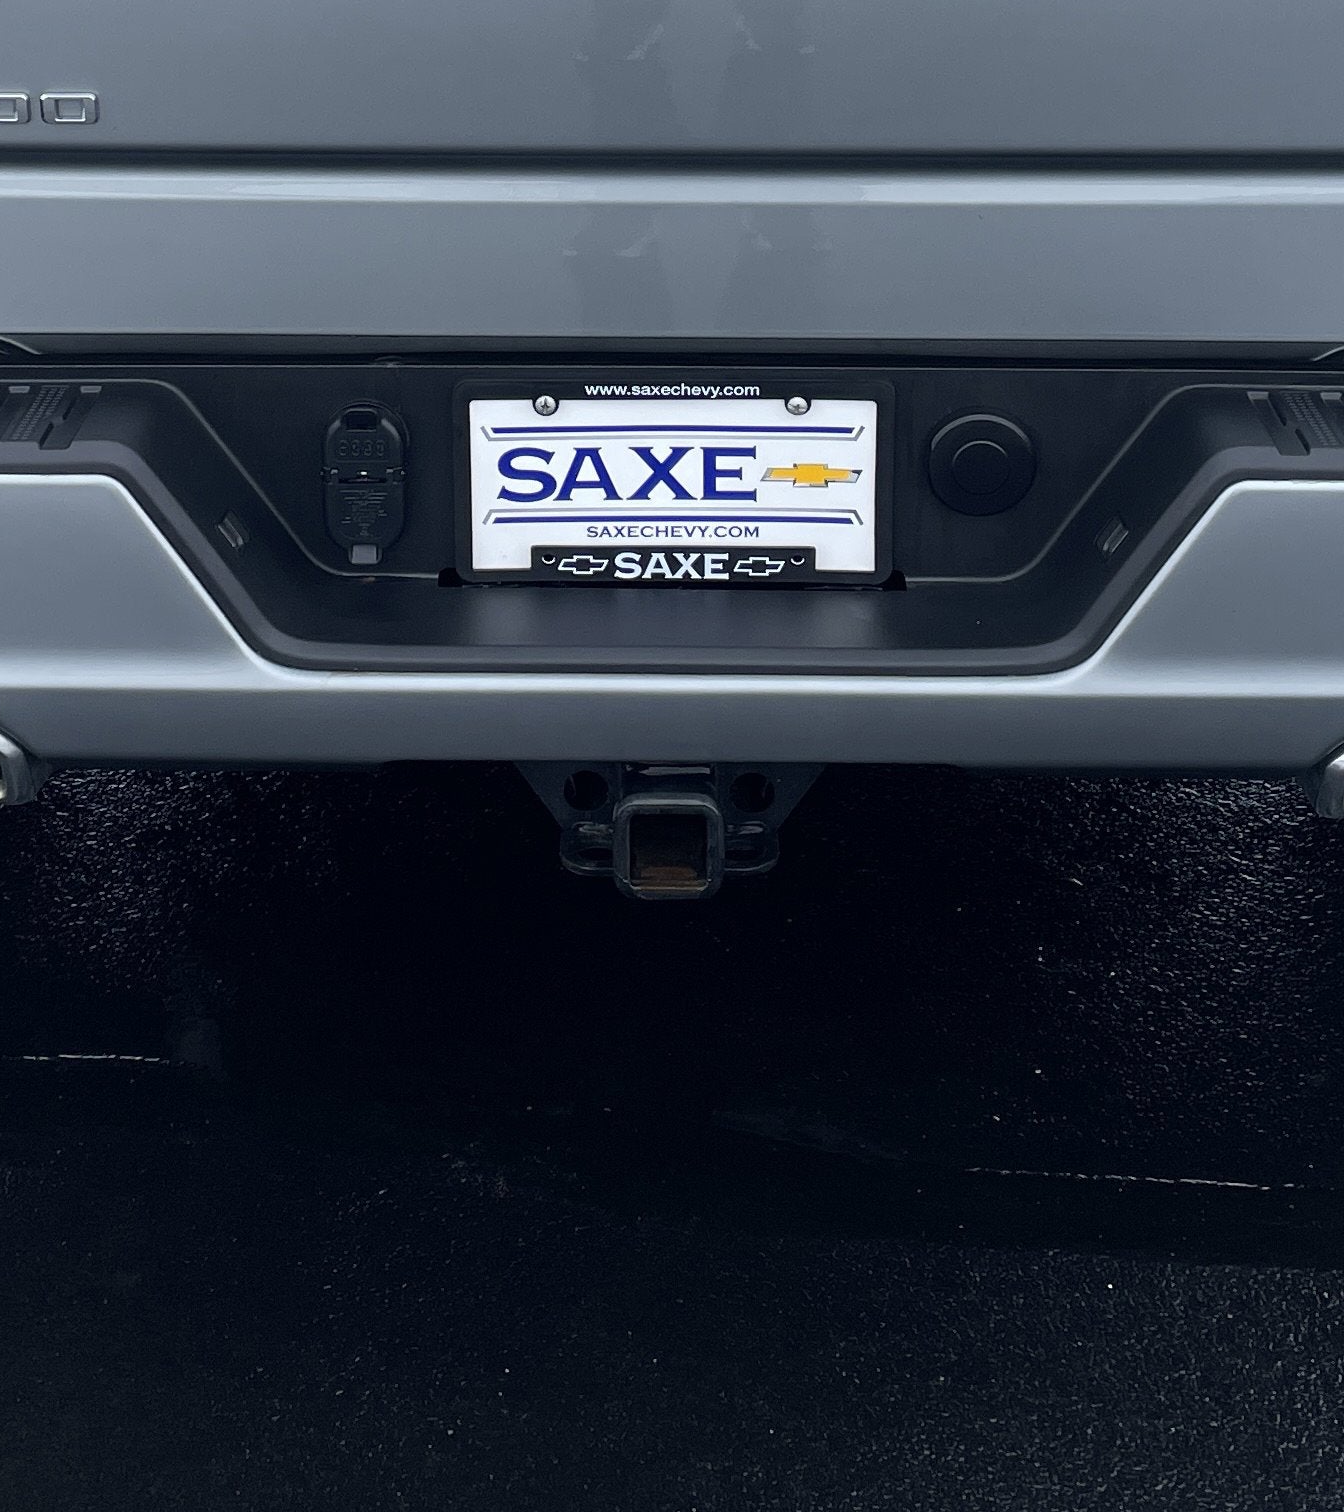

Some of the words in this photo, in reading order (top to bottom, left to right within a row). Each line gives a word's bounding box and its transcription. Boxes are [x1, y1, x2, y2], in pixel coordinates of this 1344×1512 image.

[584, 383, 760, 399] www.saxechevy.com
[496, 445, 757, 503] SAXE
[586, 525, 760, 539] SAXECHEVY.COM
[613, 551, 730, 580] SAXE
